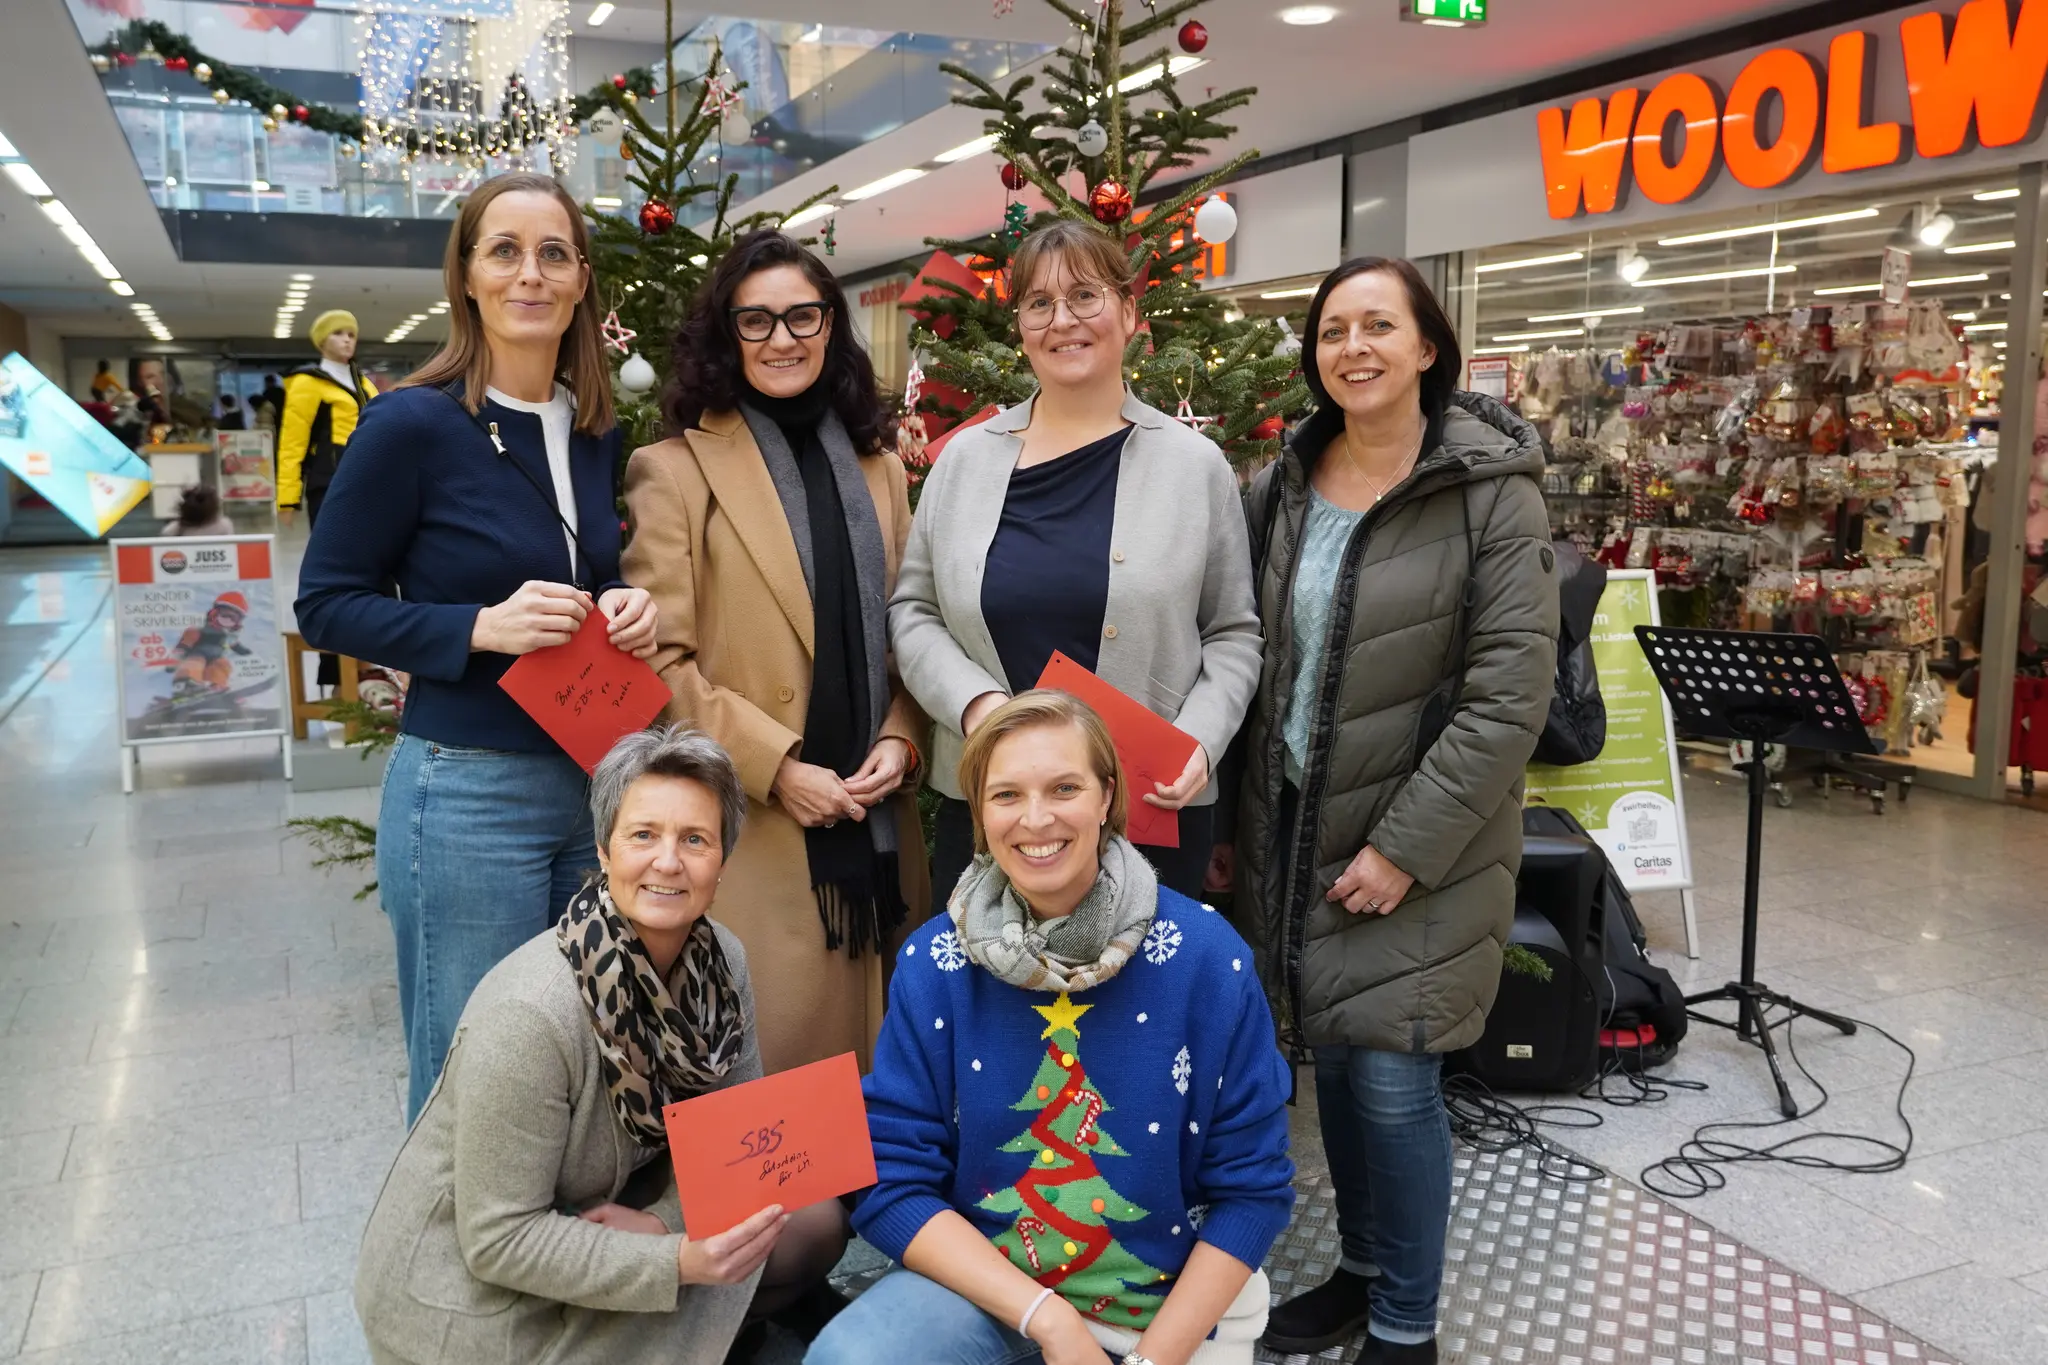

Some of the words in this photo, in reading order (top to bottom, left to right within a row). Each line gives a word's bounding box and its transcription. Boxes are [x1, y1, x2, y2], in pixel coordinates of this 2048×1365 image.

[1537, 0, 2048, 220] WOOLW
[195, 550, 226, 563] JUSS
[144, 590, 192, 601] KINDER
[125, 603, 177, 615] SAISON
[140, 632, 164, 645] ab
[574, 687, 593, 717] SBS
[1634, 856, 1672, 868] Caritas
[1636, 868, 1667, 876] Salzburg
[726, 1120, 785, 1167] SBS
